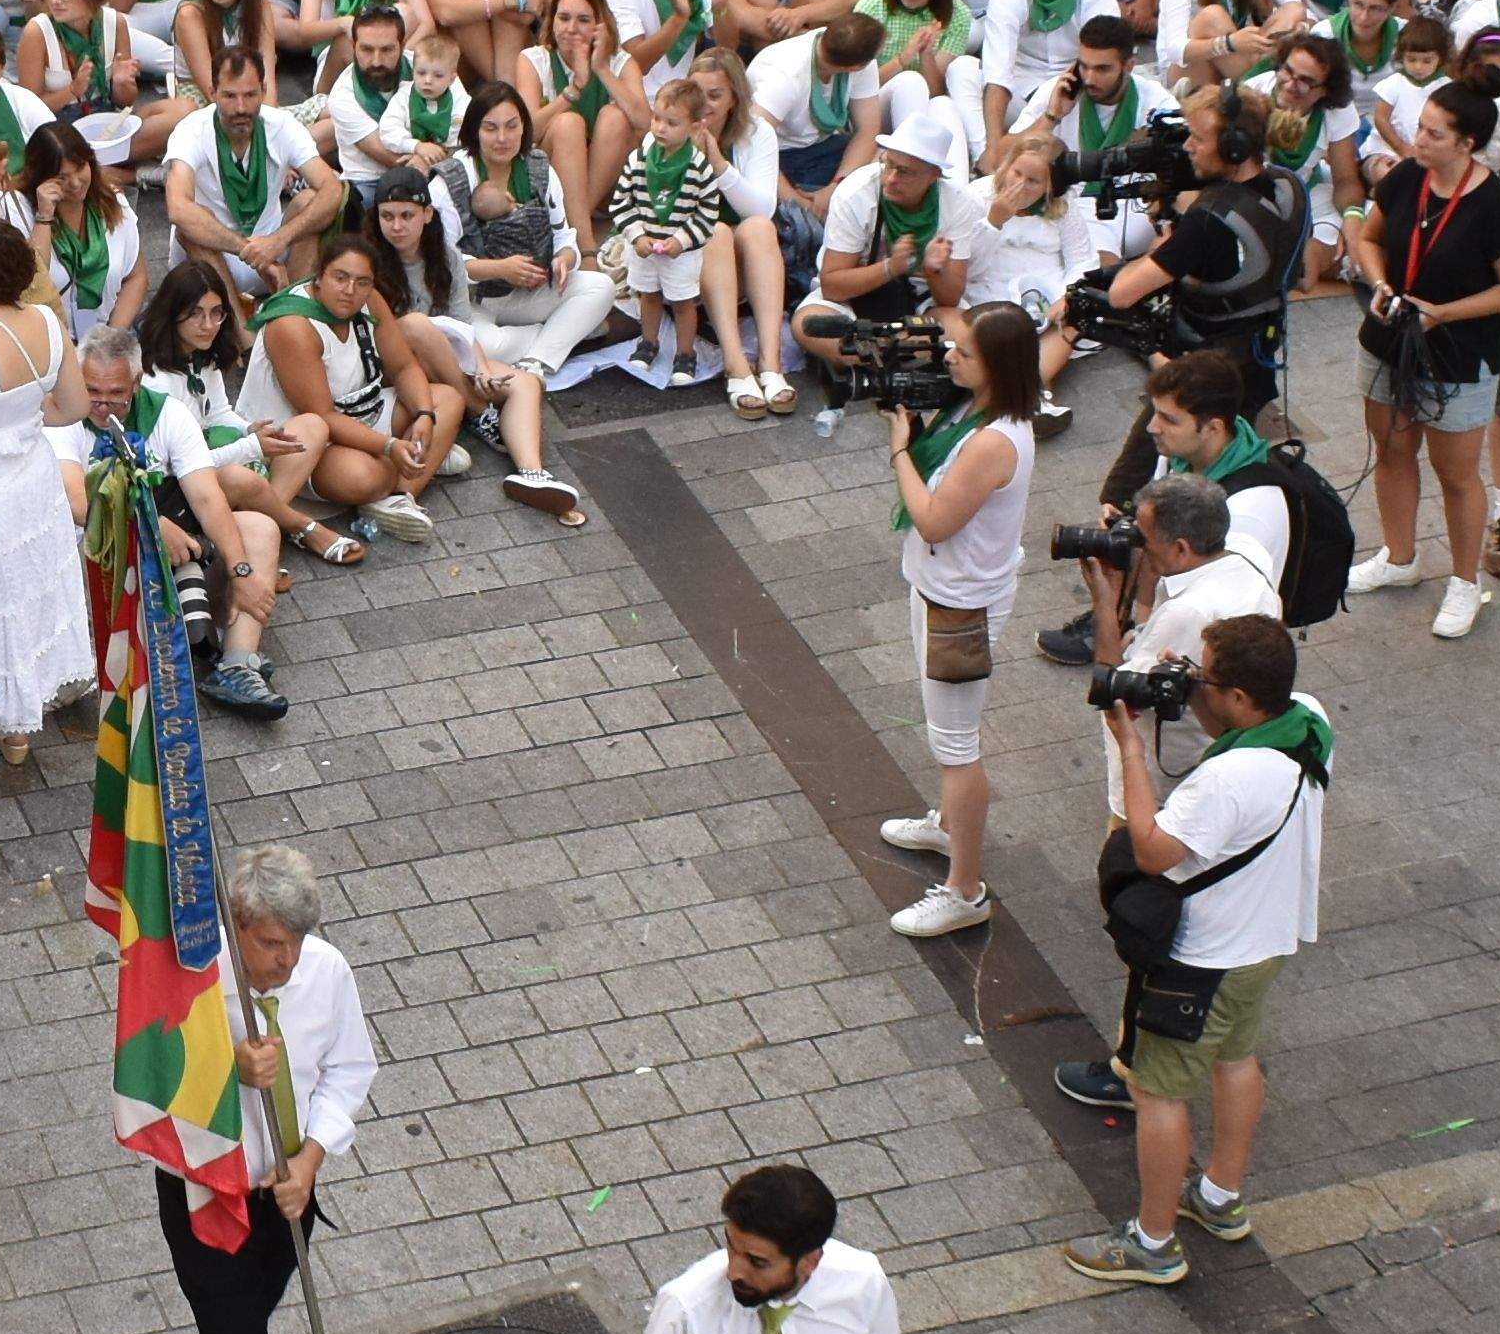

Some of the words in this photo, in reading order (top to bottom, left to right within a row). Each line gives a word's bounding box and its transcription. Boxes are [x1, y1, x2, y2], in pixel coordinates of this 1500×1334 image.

[163, 716, 193, 739] de
[163, 742, 199, 812] Bandas
[171, 815, 203, 838] de
